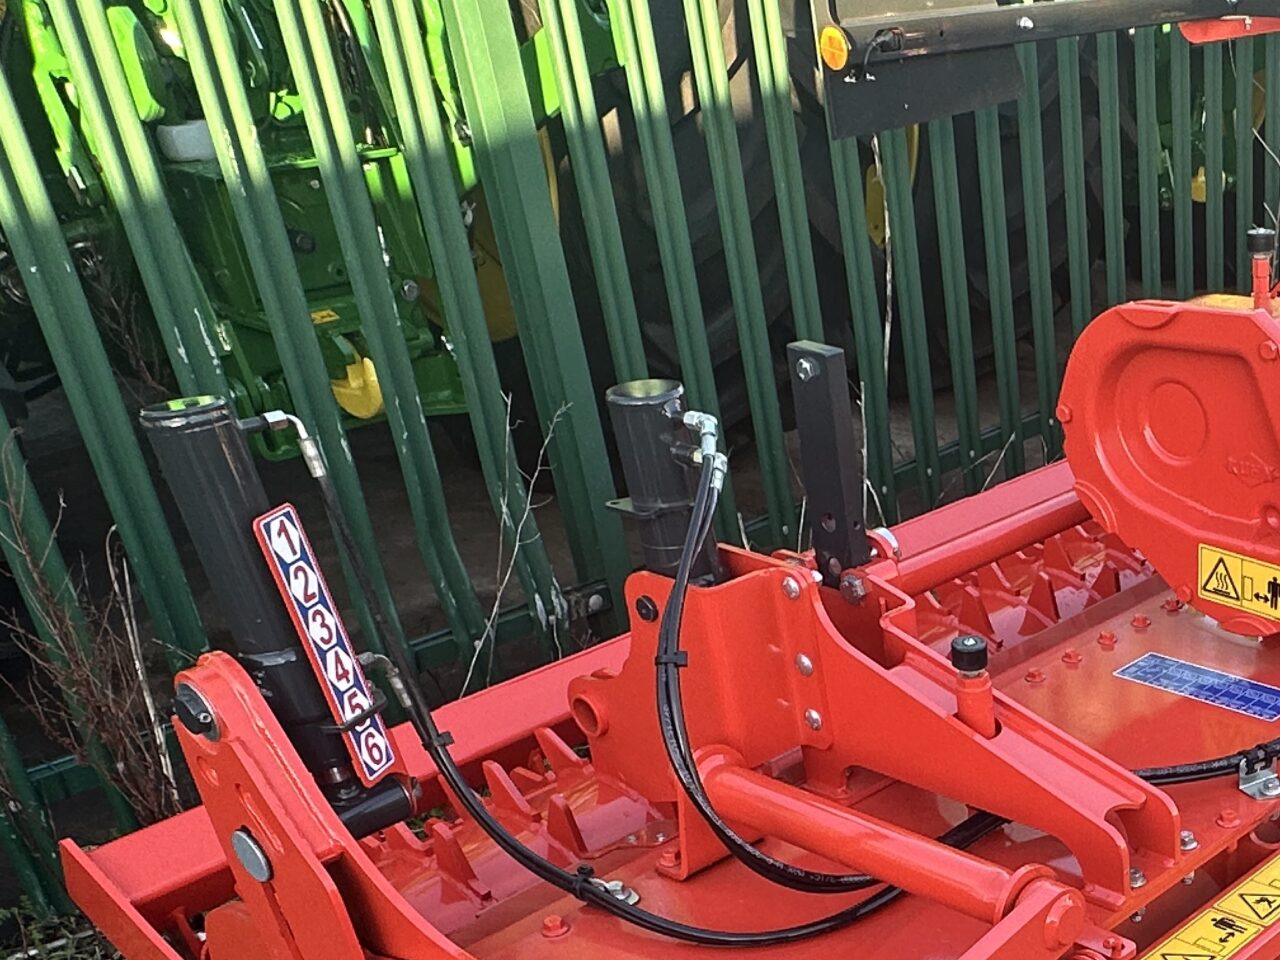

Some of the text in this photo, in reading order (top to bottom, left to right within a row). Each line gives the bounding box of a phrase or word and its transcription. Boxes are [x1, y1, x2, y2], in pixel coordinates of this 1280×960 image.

[276, 519, 298, 556] 1
[293, 565, 317, 604] 2
[312, 609, 333, 645] 3
[334, 651, 350, 685] 4
[349, 691, 371, 728] 5
[364, 732, 384, 766] 6
